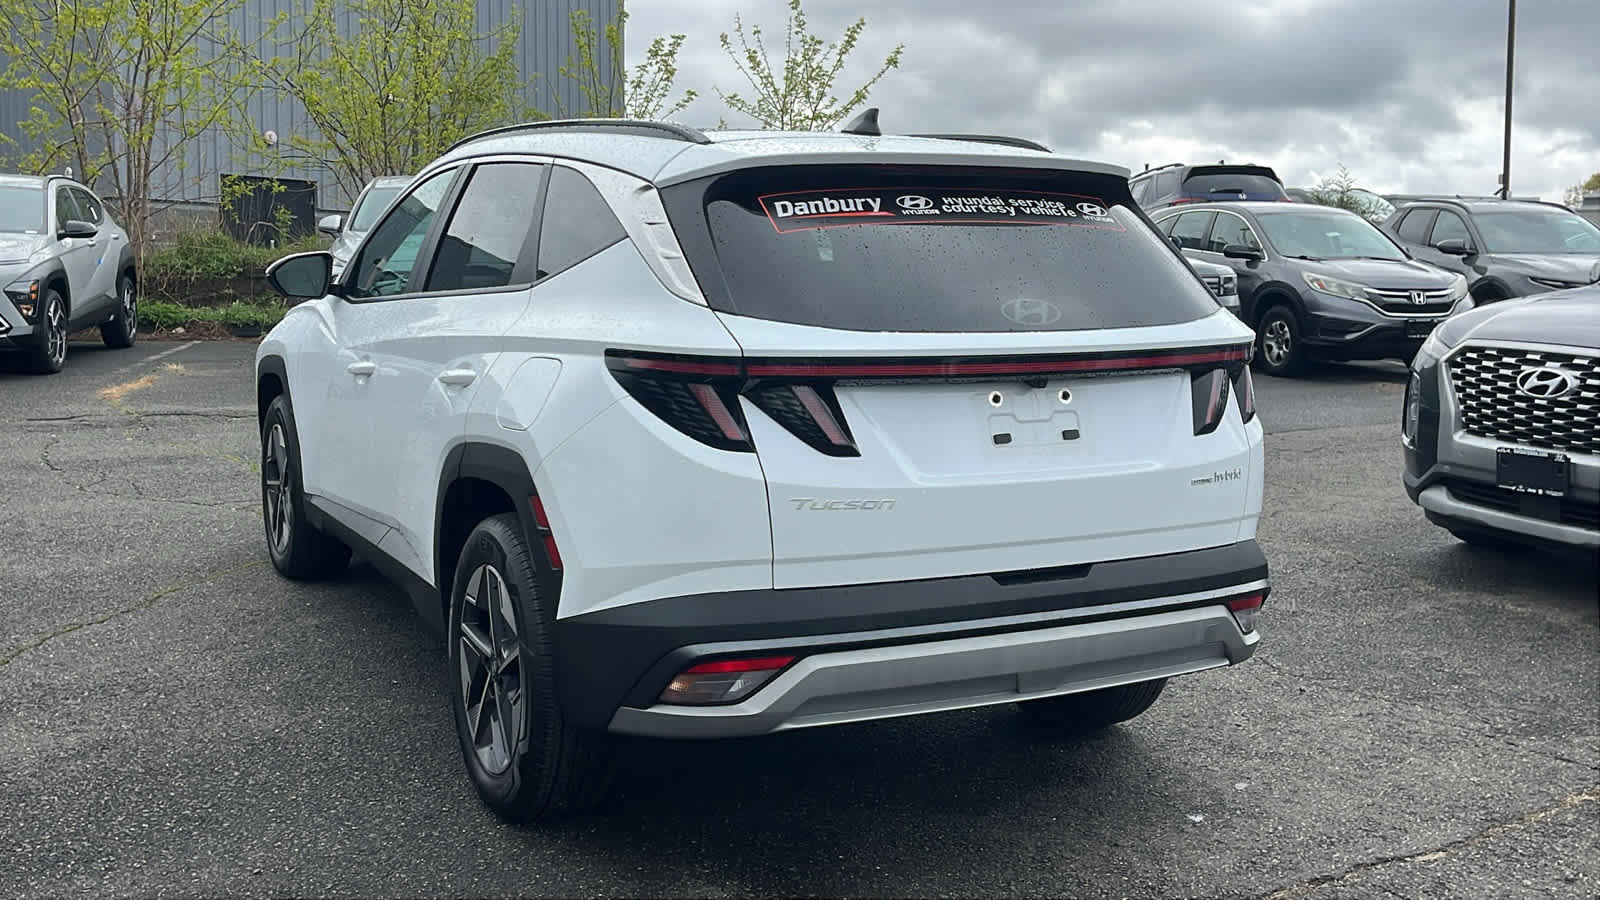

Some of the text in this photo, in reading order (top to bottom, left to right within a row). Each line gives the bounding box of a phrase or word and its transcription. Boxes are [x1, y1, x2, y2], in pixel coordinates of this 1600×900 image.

[774, 197, 881, 218] Danbury
[942, 196, 1066, 209] Hyundai service
[942, 204, 1077, 217] courtesy vehicle
